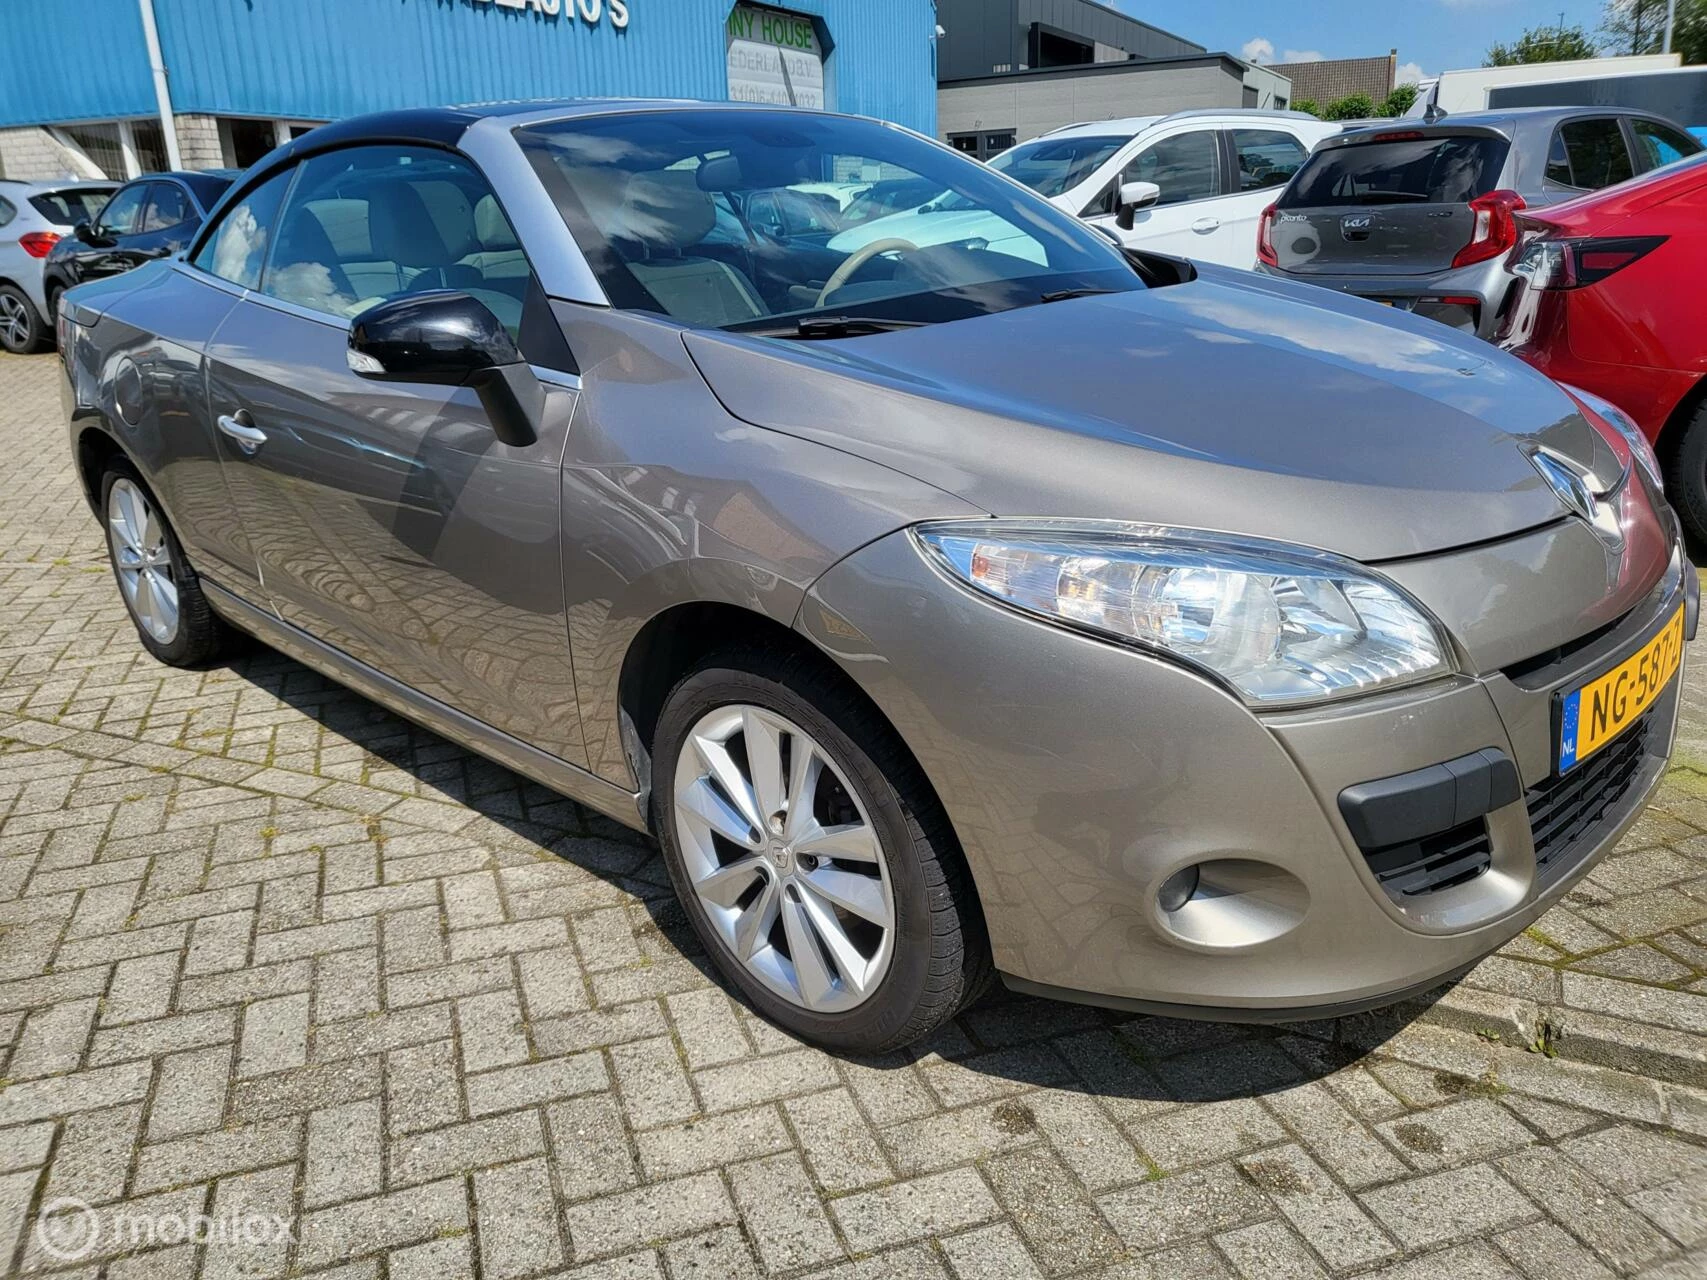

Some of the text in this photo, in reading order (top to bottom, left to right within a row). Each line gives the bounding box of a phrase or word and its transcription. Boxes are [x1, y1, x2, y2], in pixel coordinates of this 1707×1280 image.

[762, 16, 813, 49] HOUSE
[730, 49, 795, 75] EDERLAD
[1590, 615, 1681, 742] NG-587-Z
[1562, 737, 1575, 757] NL
